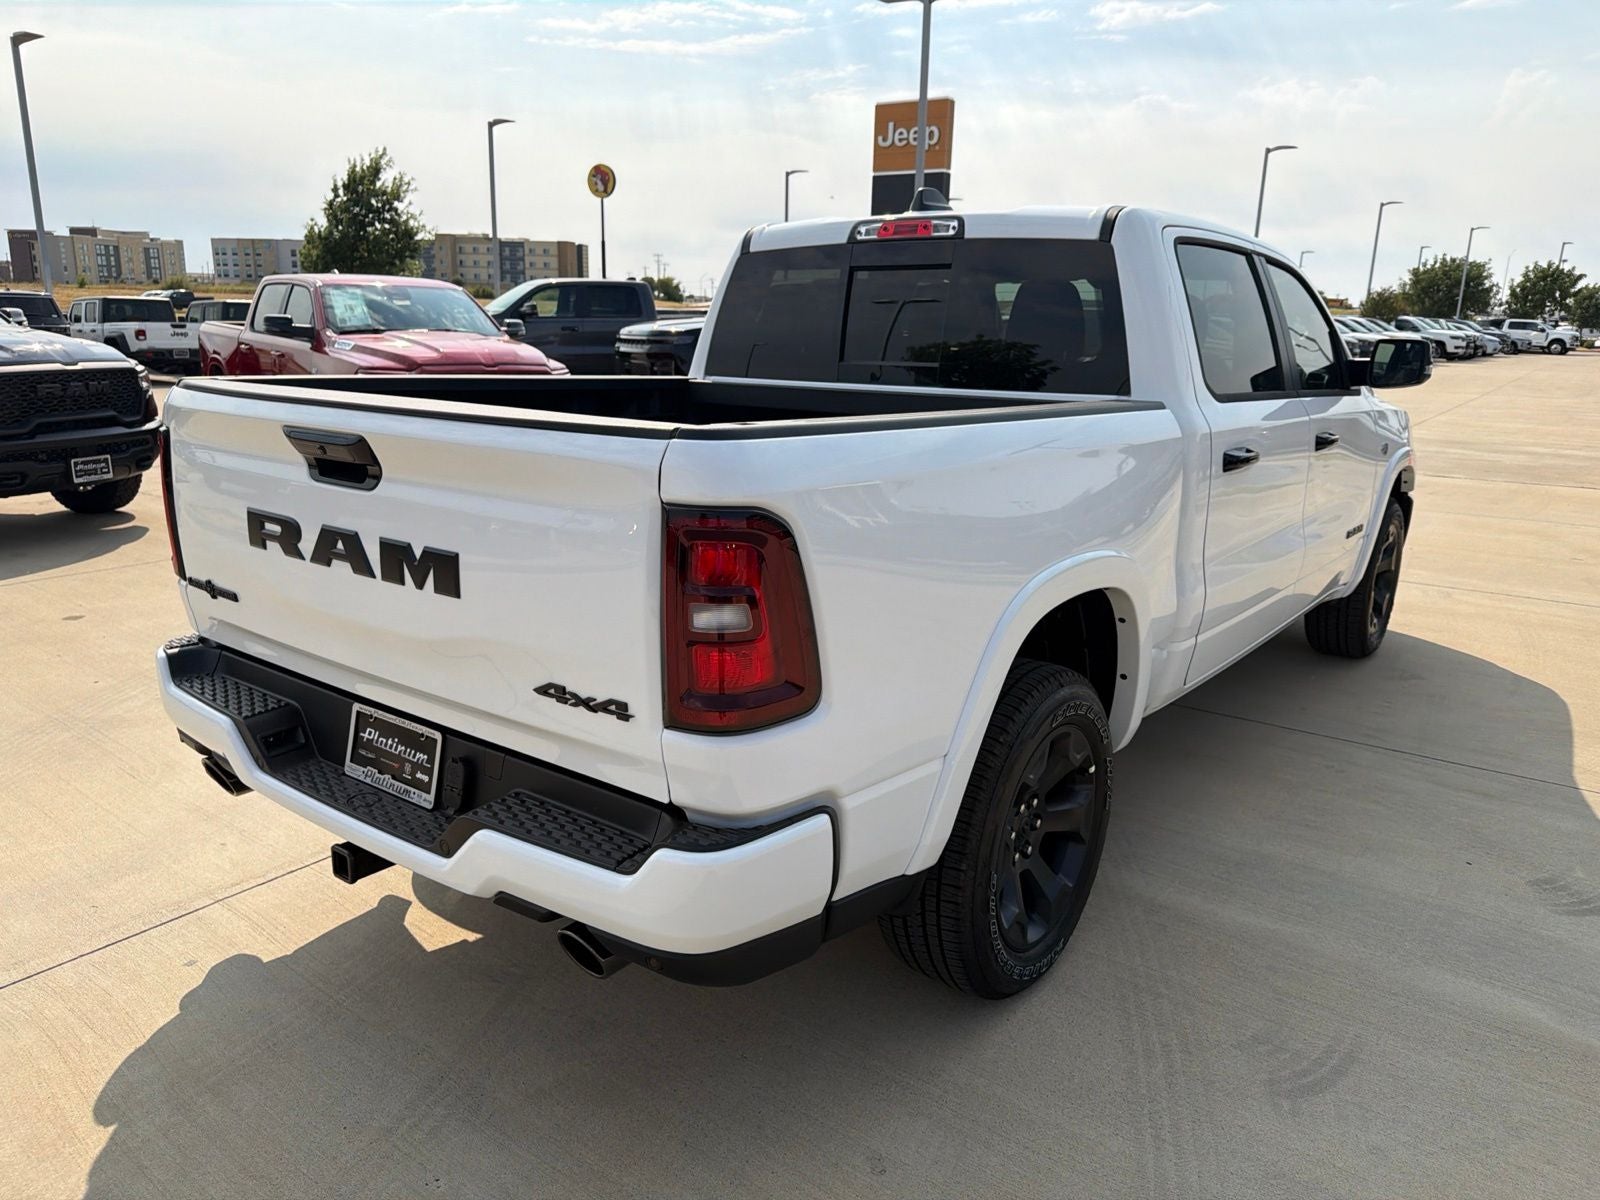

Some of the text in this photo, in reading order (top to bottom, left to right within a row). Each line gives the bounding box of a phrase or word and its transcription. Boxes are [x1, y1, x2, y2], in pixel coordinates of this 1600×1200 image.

[877, 121, 940, 151] Jeep
[170, 330, 189, 339] Jeep
[36, 380, 111, 398] RAM
[246, 507, 461, 599] RAM
[359, 727, 431, 768] Platinum
[363, 767, 415, 801] Platinum
[415, 770, 430, 783] Jeep
